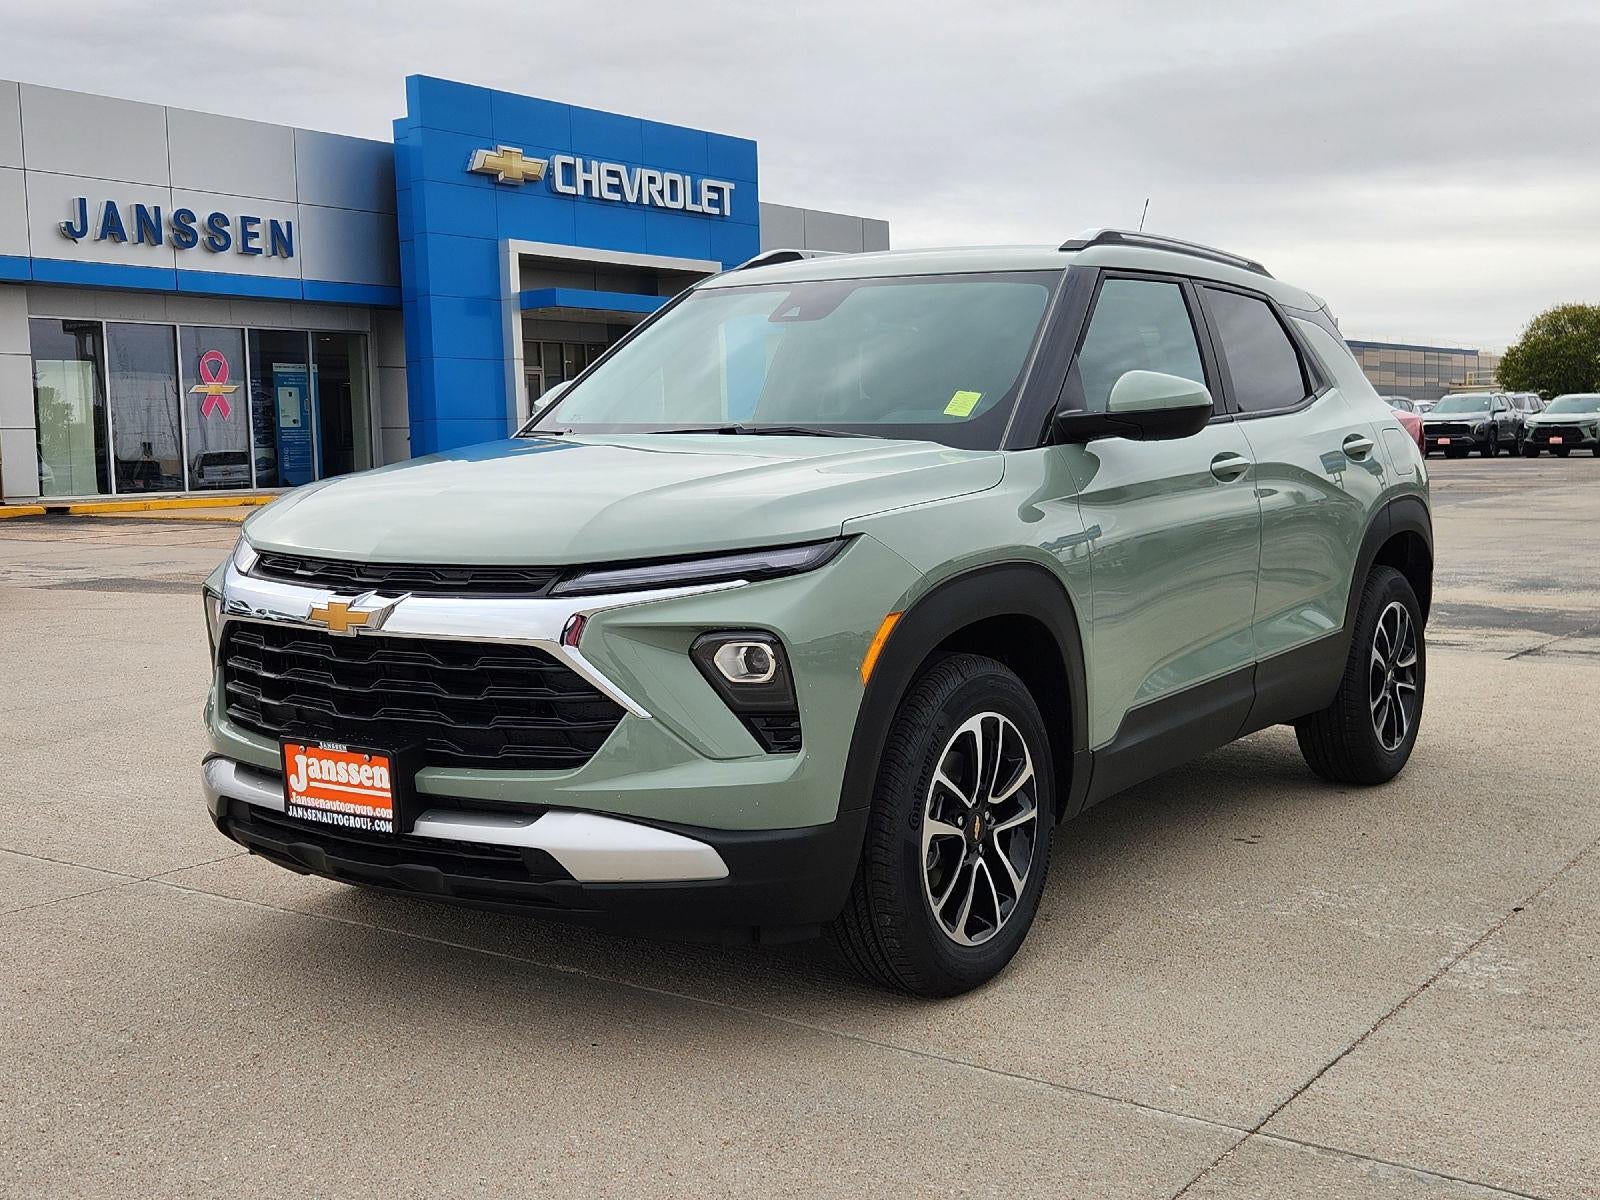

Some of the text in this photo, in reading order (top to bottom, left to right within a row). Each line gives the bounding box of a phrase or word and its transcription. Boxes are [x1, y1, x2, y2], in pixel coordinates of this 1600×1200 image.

[552, 154, 735, 217] CHEVROLET
[60, 197, 294, 258] JANSSEN
[290, 754, 390, 792] Janssen
